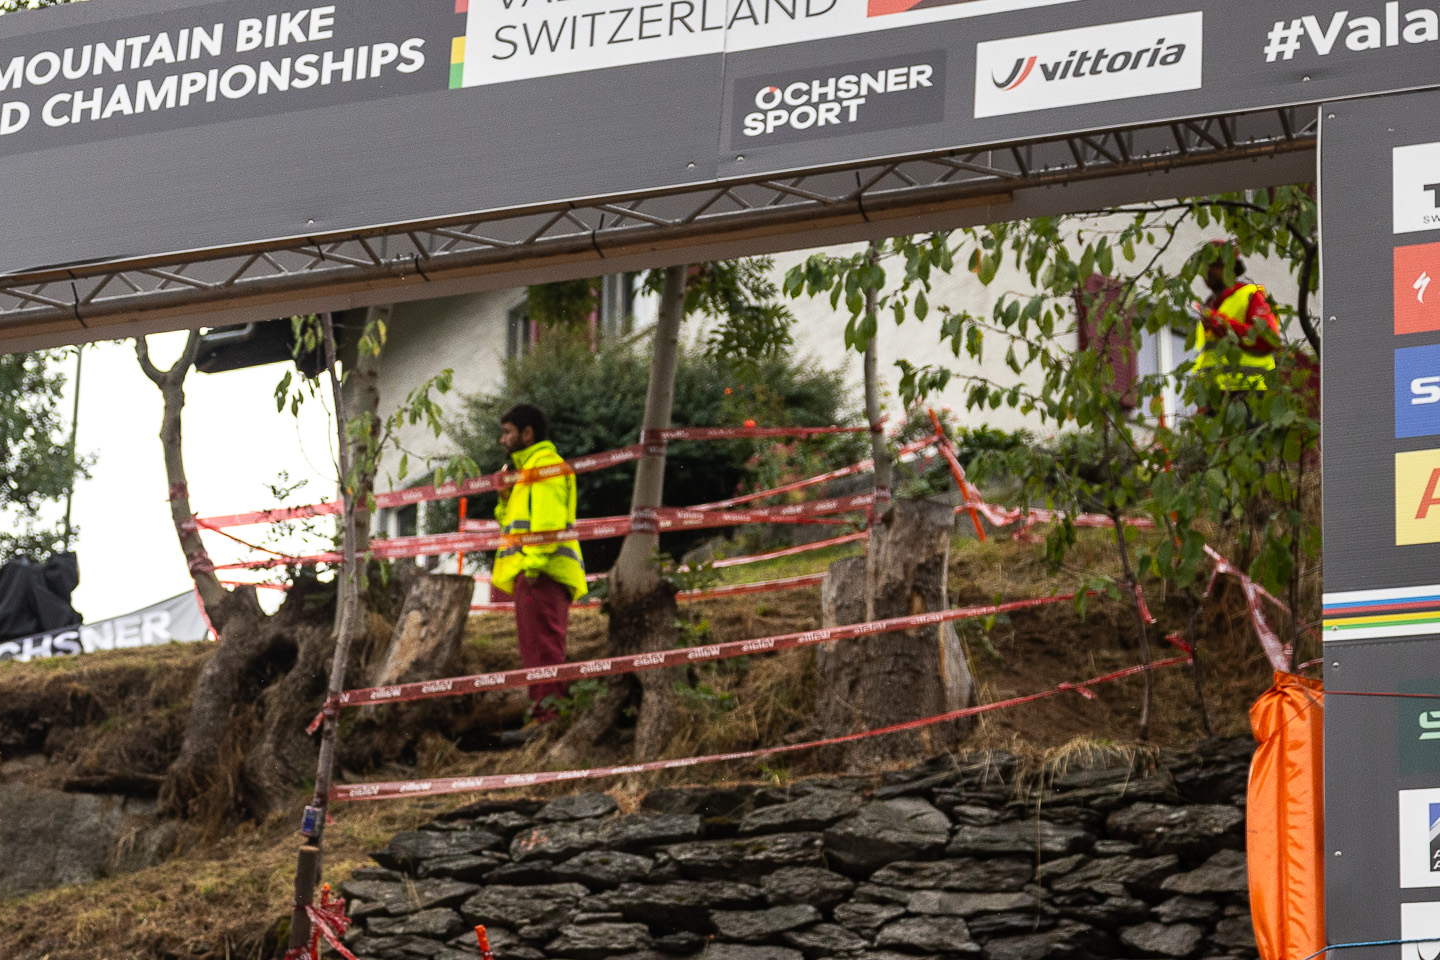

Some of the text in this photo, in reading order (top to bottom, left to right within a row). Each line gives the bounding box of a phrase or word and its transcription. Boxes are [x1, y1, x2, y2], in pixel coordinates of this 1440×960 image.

[235, 5, 336, 52] BIKE
[41, 38, 426, 127] CHAMPIONSHIPS
[1039, 37, 1187, 81] vittoria
[754, 63, 933, 110] OCHSNER
[742, 97, 866, 137] SPORT
